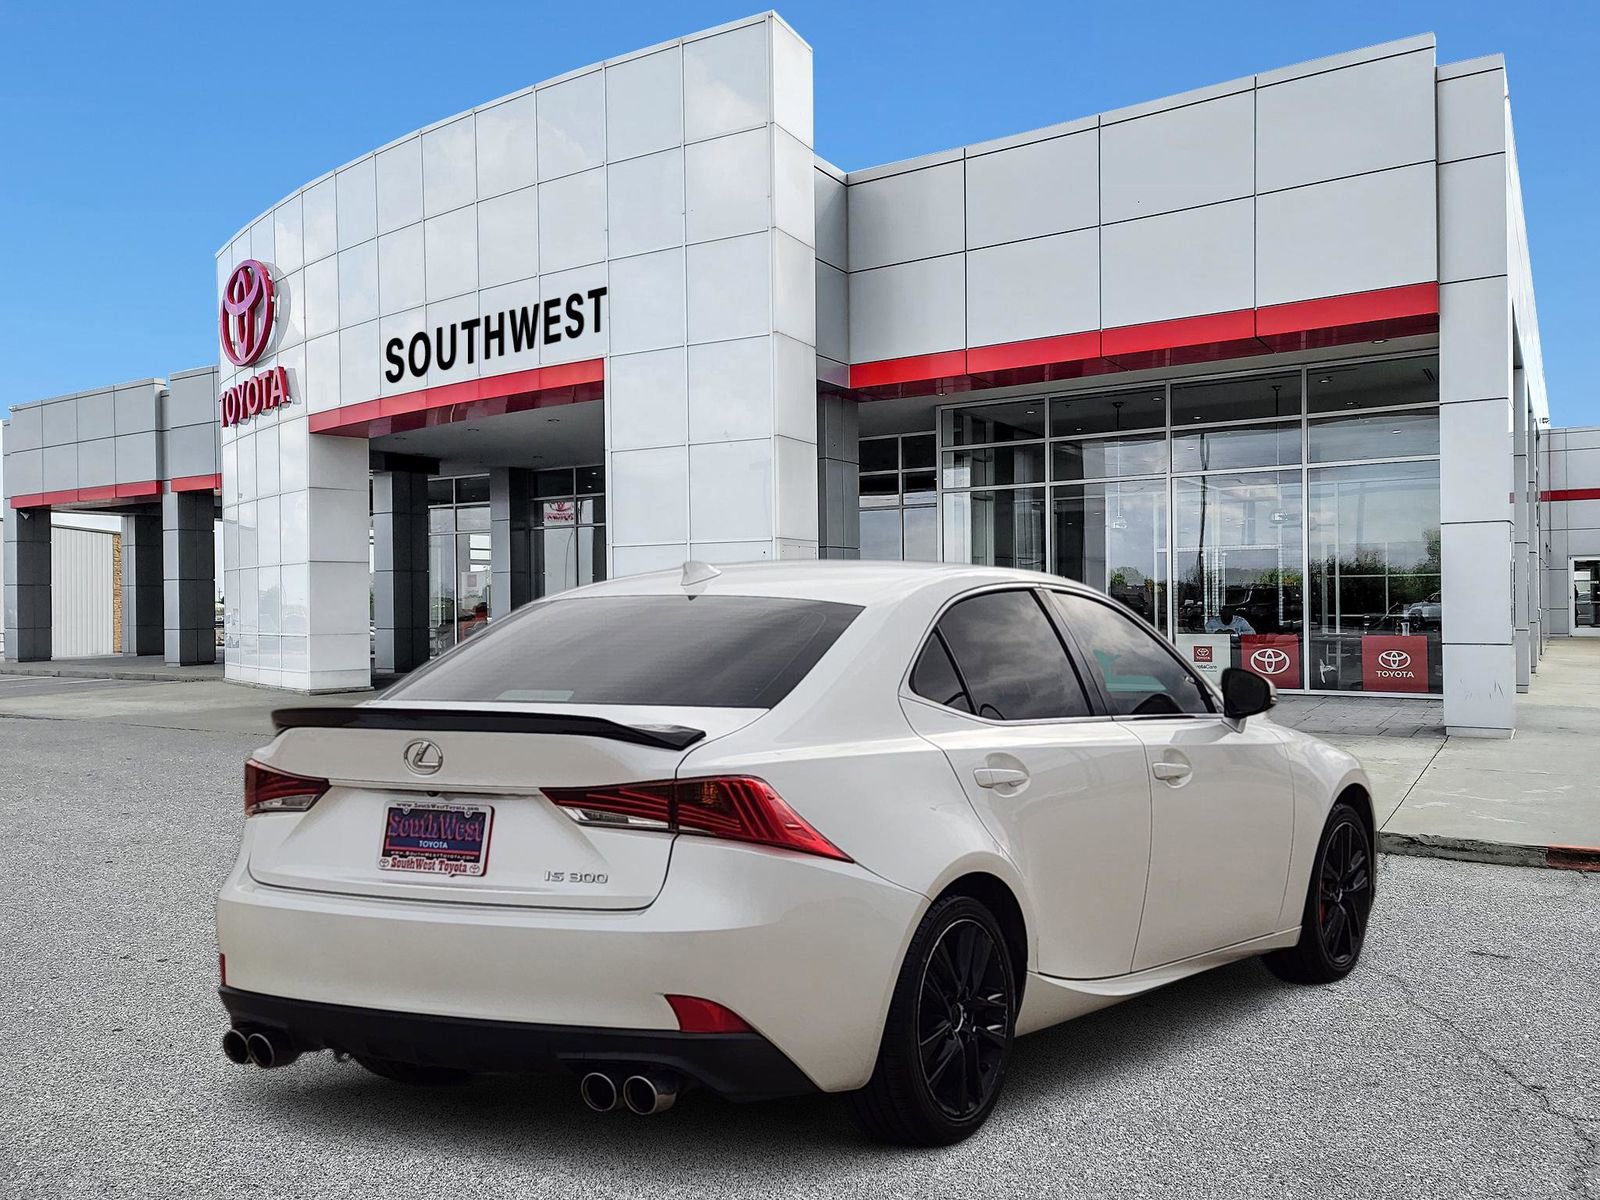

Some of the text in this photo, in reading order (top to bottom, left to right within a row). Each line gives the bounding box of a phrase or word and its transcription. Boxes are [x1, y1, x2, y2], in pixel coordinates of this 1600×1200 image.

[385, 287, 608, 384] SOUTHWEST
[218, 366, 288, 428] TOYOTA
[1376, 670, 1414, 678] TOYOTA
[419, 840, 448, 849] TOYOTA
[438, 859, 468, 874] Toyota
[544, 871, 609, 885] IS 300
